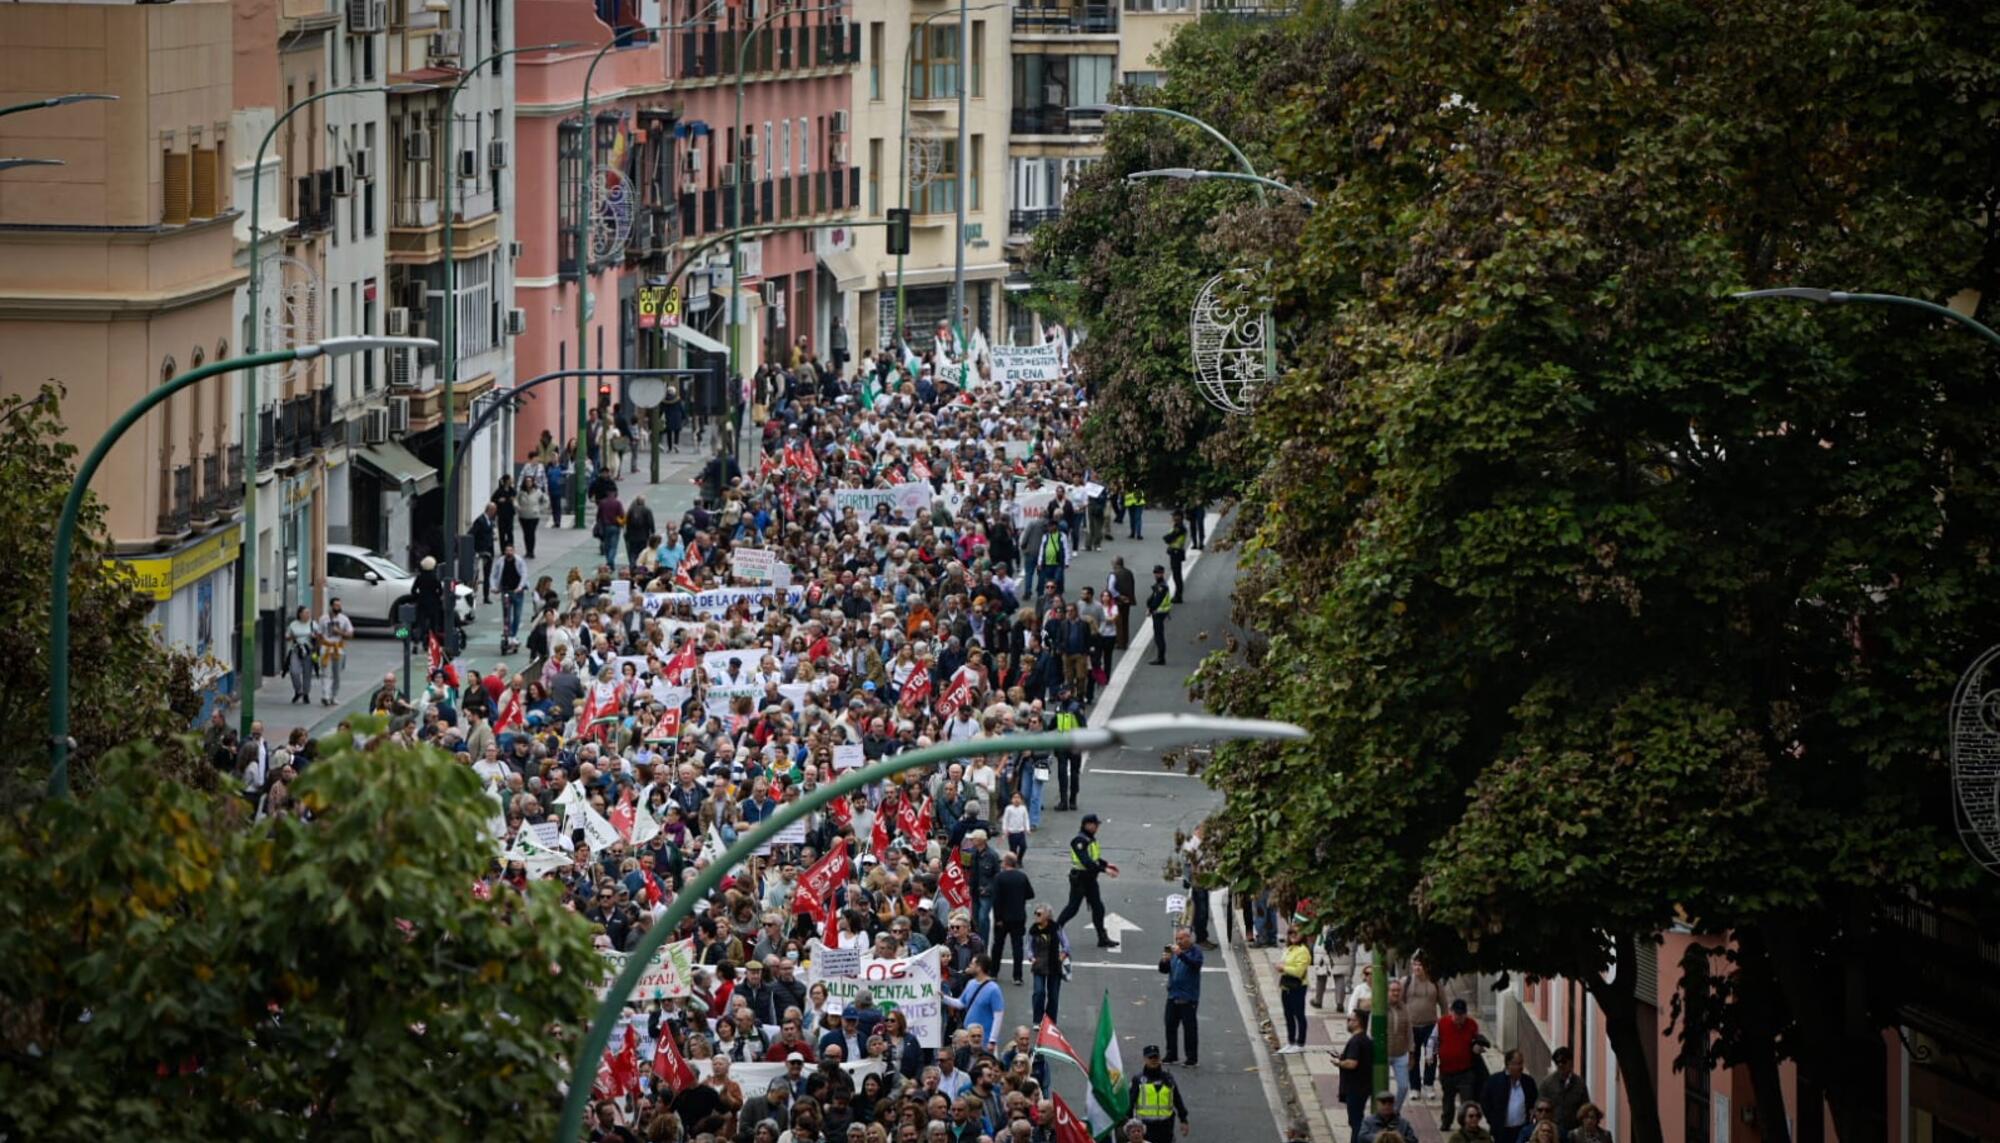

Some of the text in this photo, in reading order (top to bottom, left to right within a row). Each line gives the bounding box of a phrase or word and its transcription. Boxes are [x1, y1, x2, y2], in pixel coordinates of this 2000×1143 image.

[641, 288, 678, 301] COMPO
[643, 302, 675, 314] OO
[1007, 369, 1044, 379] GILENA
[700, 596, 714, 607] DE
[716, 594, 729, 605] LA
[868, 984, 917, 999] MENTAL
[921, 983, 933, 997] YA
